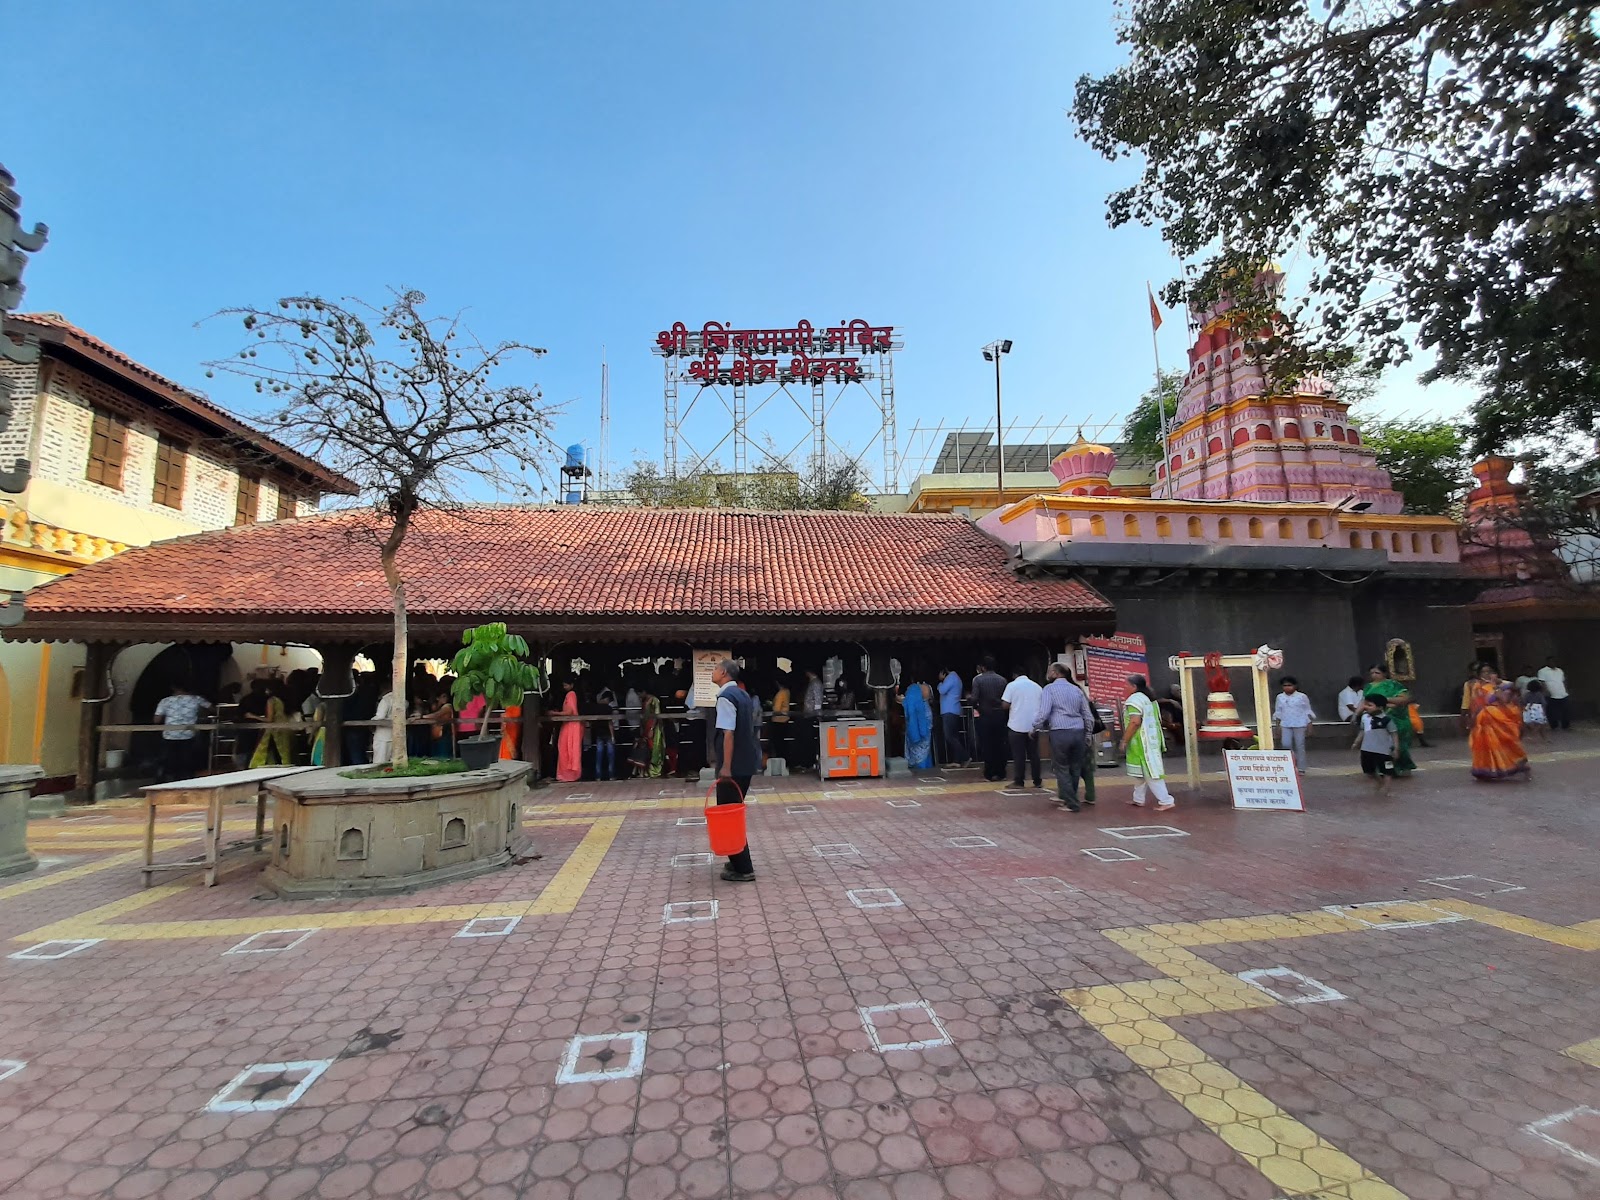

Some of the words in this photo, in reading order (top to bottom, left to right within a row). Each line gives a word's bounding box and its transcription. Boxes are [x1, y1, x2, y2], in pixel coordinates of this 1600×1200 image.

[656, 321, 688, 350] श्री
[701, 319, 815, 349] चिंतामणी
[826, 318, 894, 347] मंदिर
[688, 350, 720, 380] श्री
[730, 350, 778, 381] क्षेत्र
[790, 350, 859, 378] थेऊर
